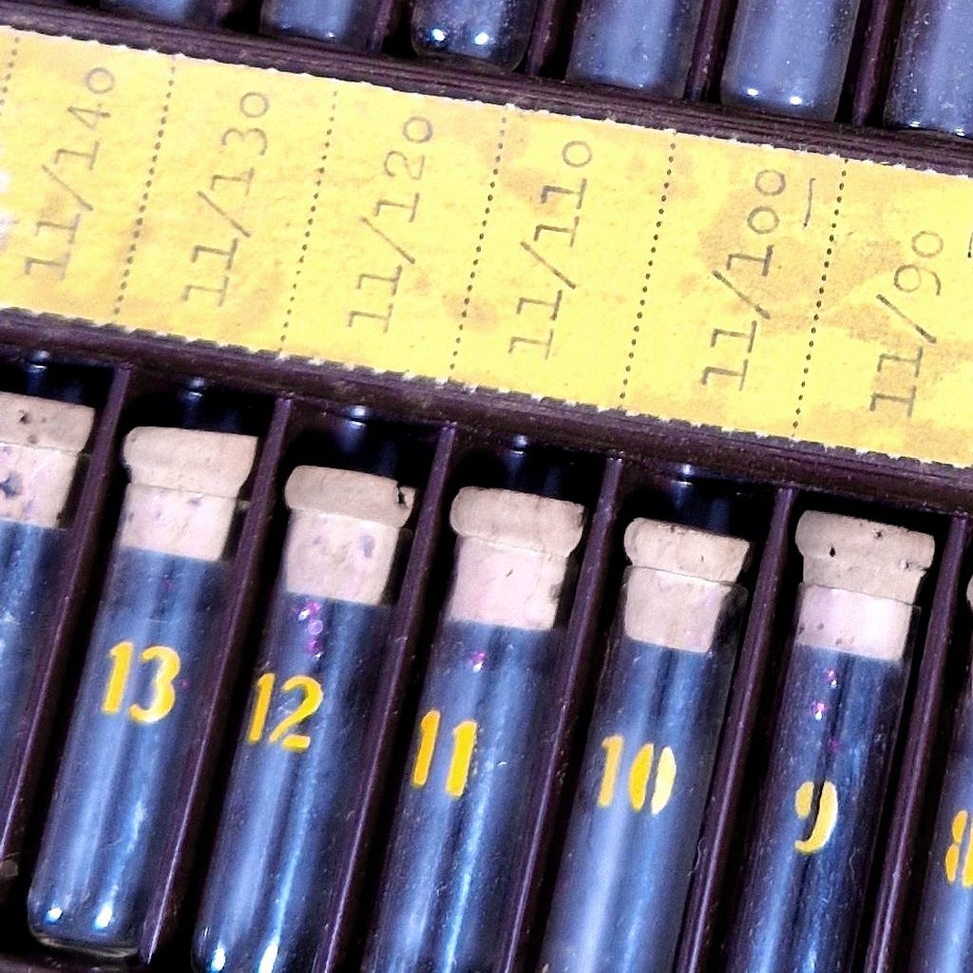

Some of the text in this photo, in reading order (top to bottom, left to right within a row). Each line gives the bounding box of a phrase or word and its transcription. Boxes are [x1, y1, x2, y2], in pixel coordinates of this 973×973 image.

[24, 67, 115, 280] 11/140
[181, 90, 271, 307] 11/130
[347, 116, 434, 333] 11/120
[508, 140, 594, 361] 11/110
[700, 168, 786, 391] 11/100
[870, 230, 945, 418] 11/90
[103, 643, 180, 721] 13
[247, 672, 321, 752] 12
[411, 710, 477, 797] 11
[600, 736, 677, 814] 10
[795, 780, 838, 854] 9
